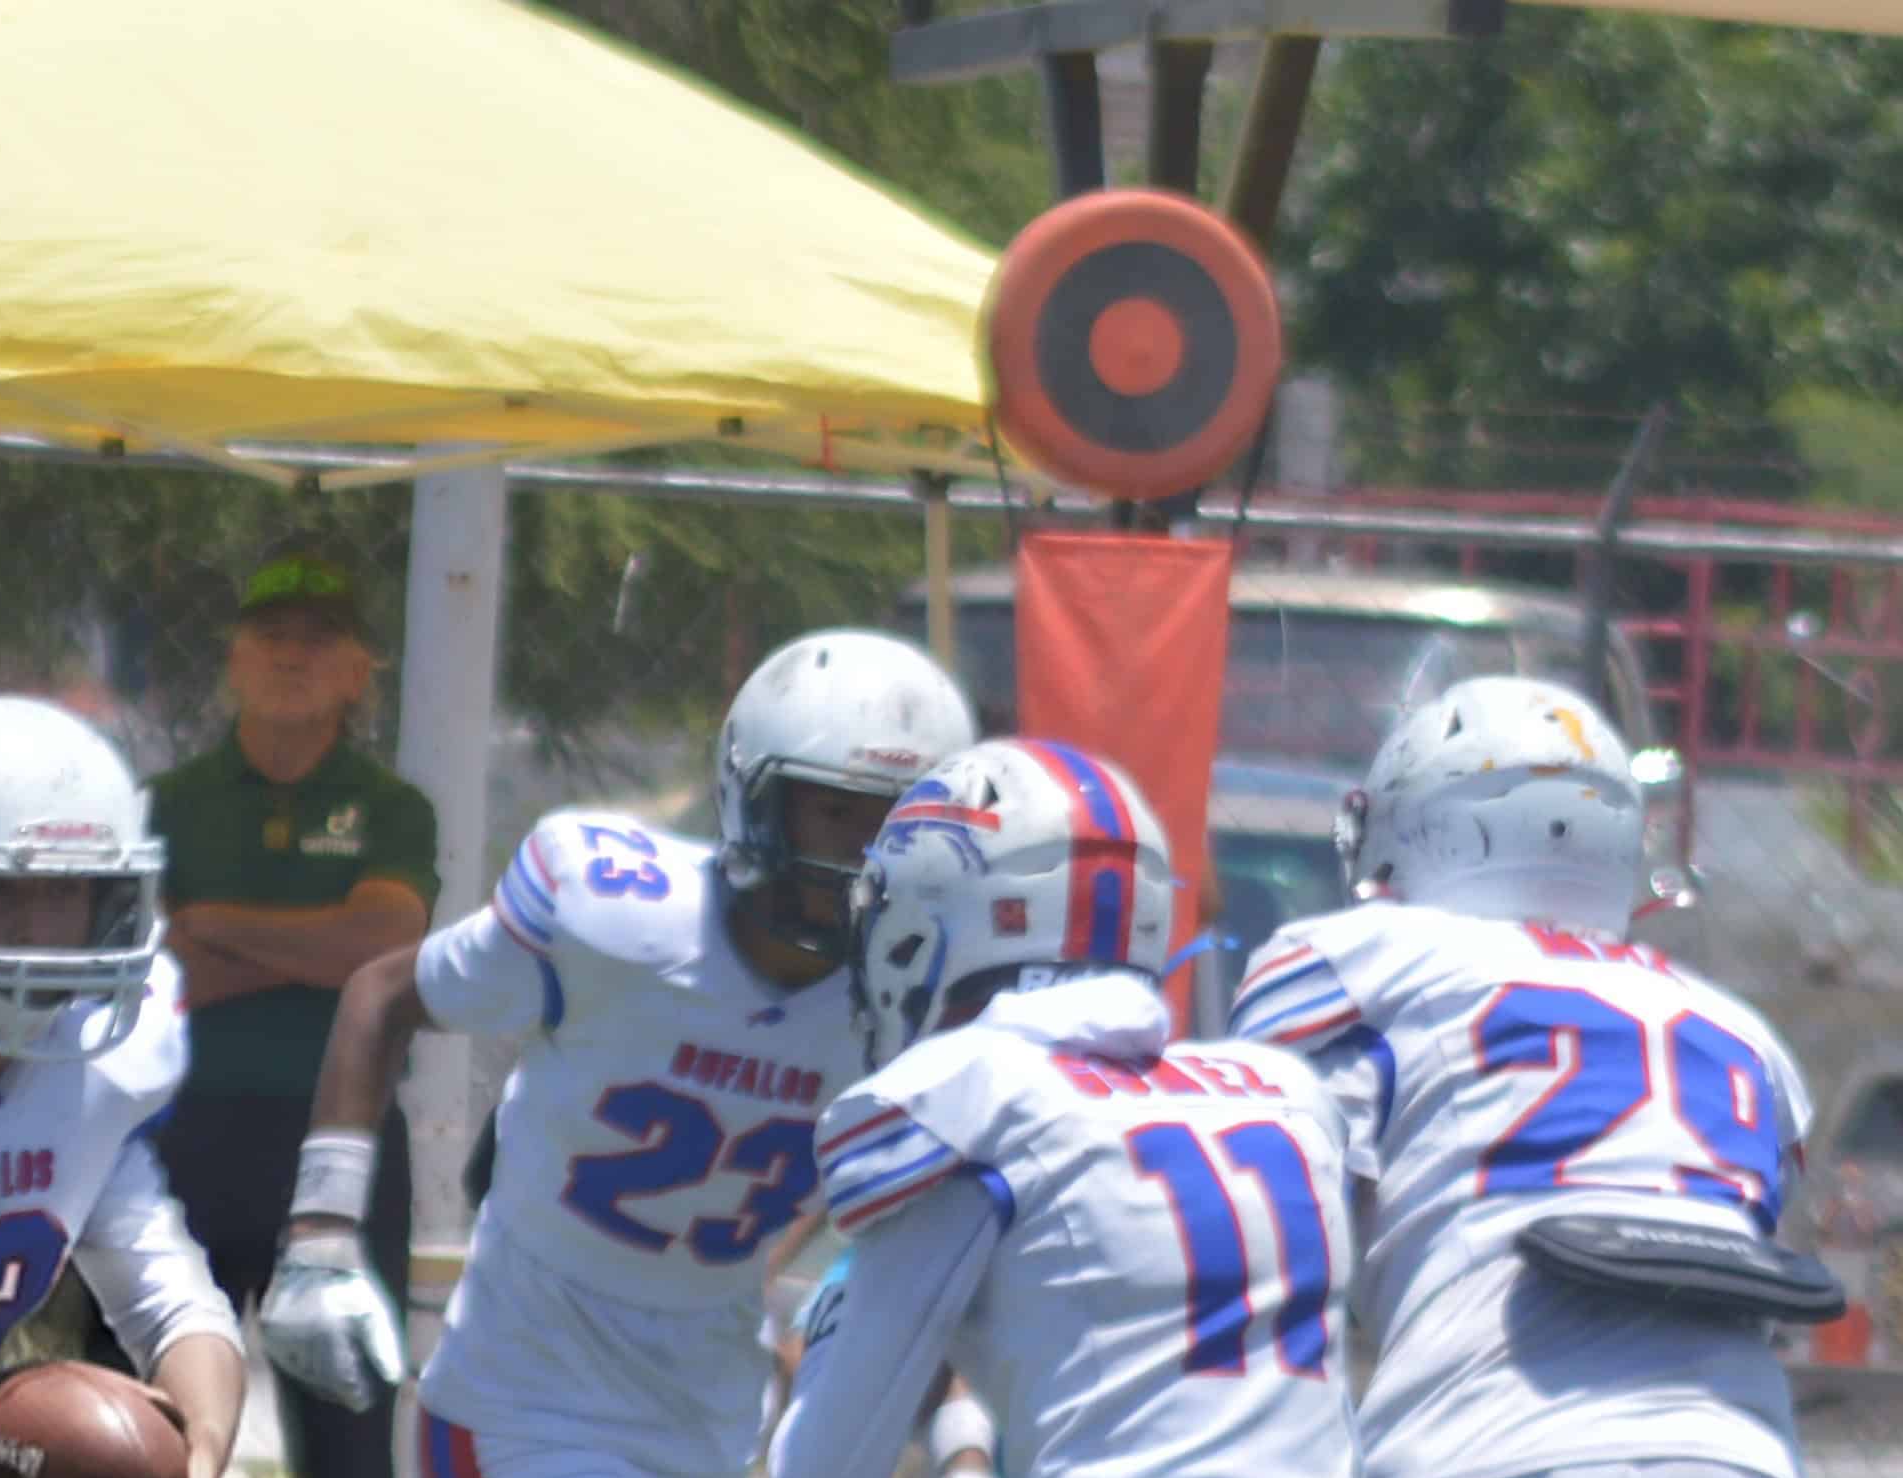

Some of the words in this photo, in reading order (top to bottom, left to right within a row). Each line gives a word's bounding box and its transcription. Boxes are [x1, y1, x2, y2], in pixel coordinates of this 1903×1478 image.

[578, 824, 671, 902] 23
[669, 1041, 824, 1106] BUFALOS
[1471, 980, 1779, 1236] 29
[560, 1079, 820, 1267] 23
[1123, 1122, 1329, 1382] 11
